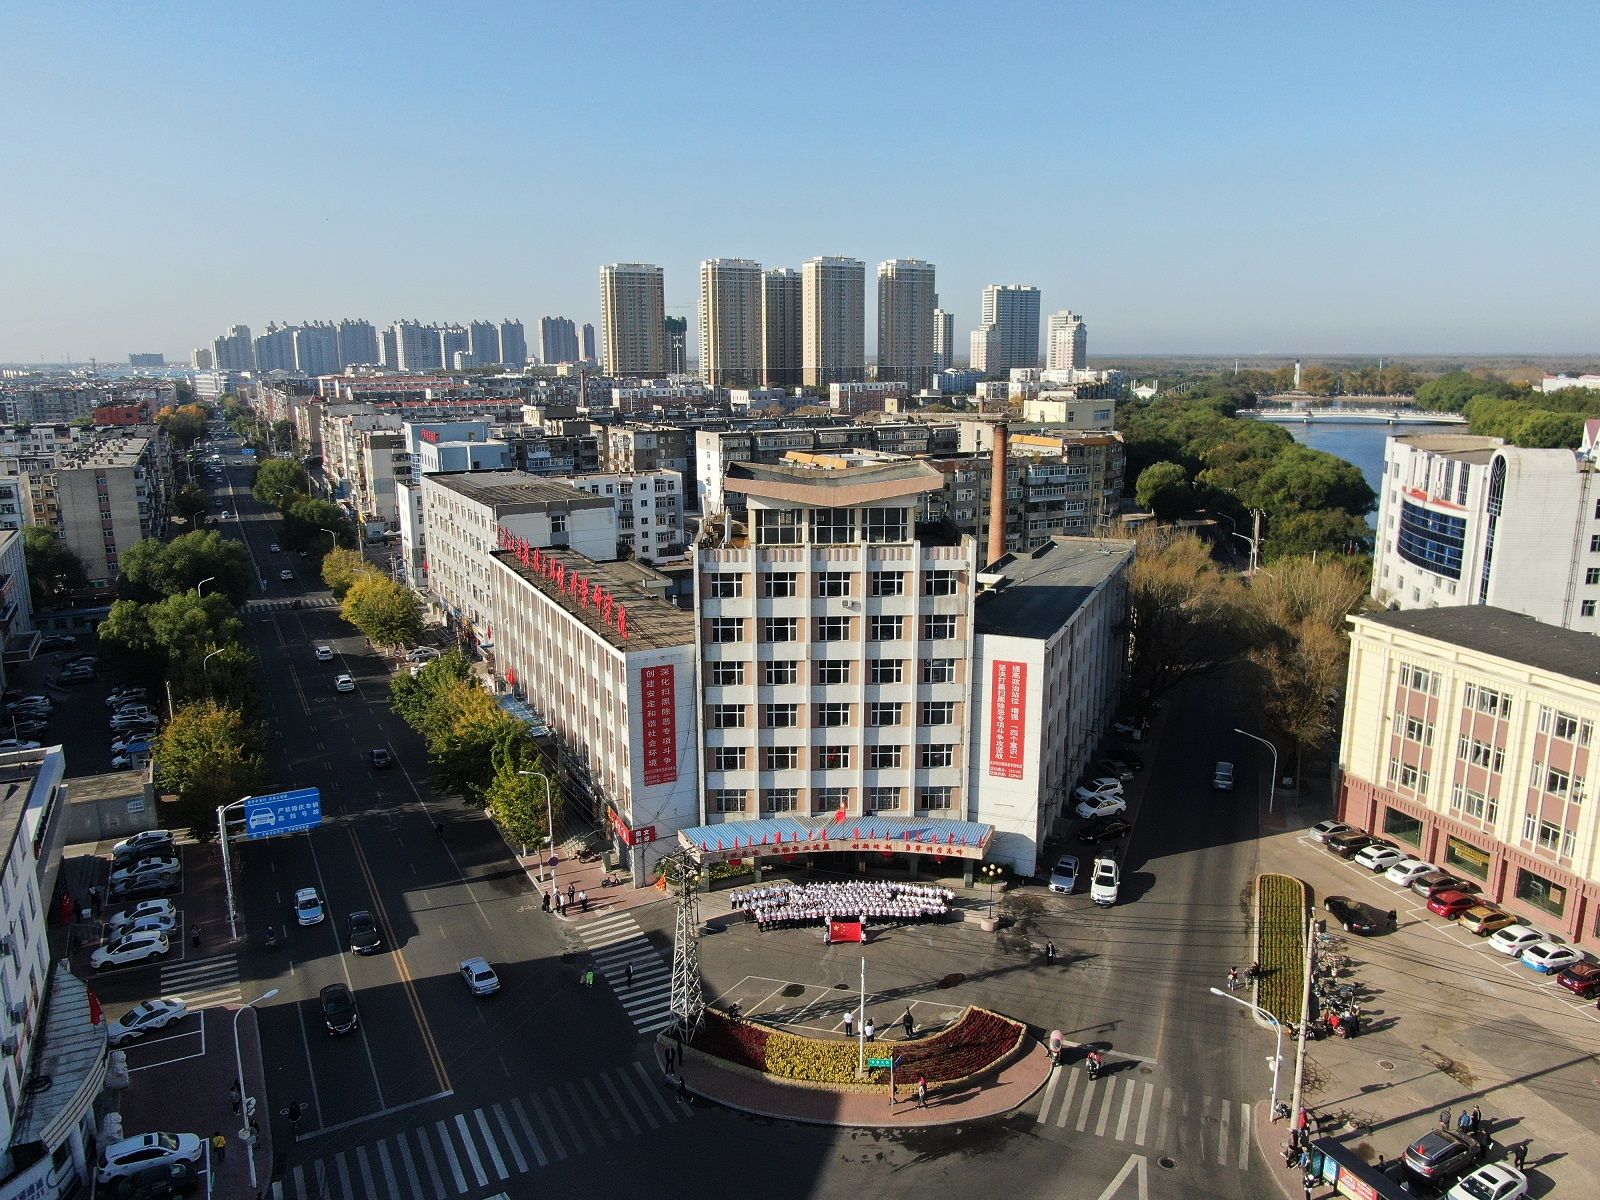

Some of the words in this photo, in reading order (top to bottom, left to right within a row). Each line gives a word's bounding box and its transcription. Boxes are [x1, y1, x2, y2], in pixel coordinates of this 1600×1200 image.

[646, 669, 658, 767] 创建安定和谐社会环境
[660, 667, 672, 765] 深化扫黑除恶专项斗争
